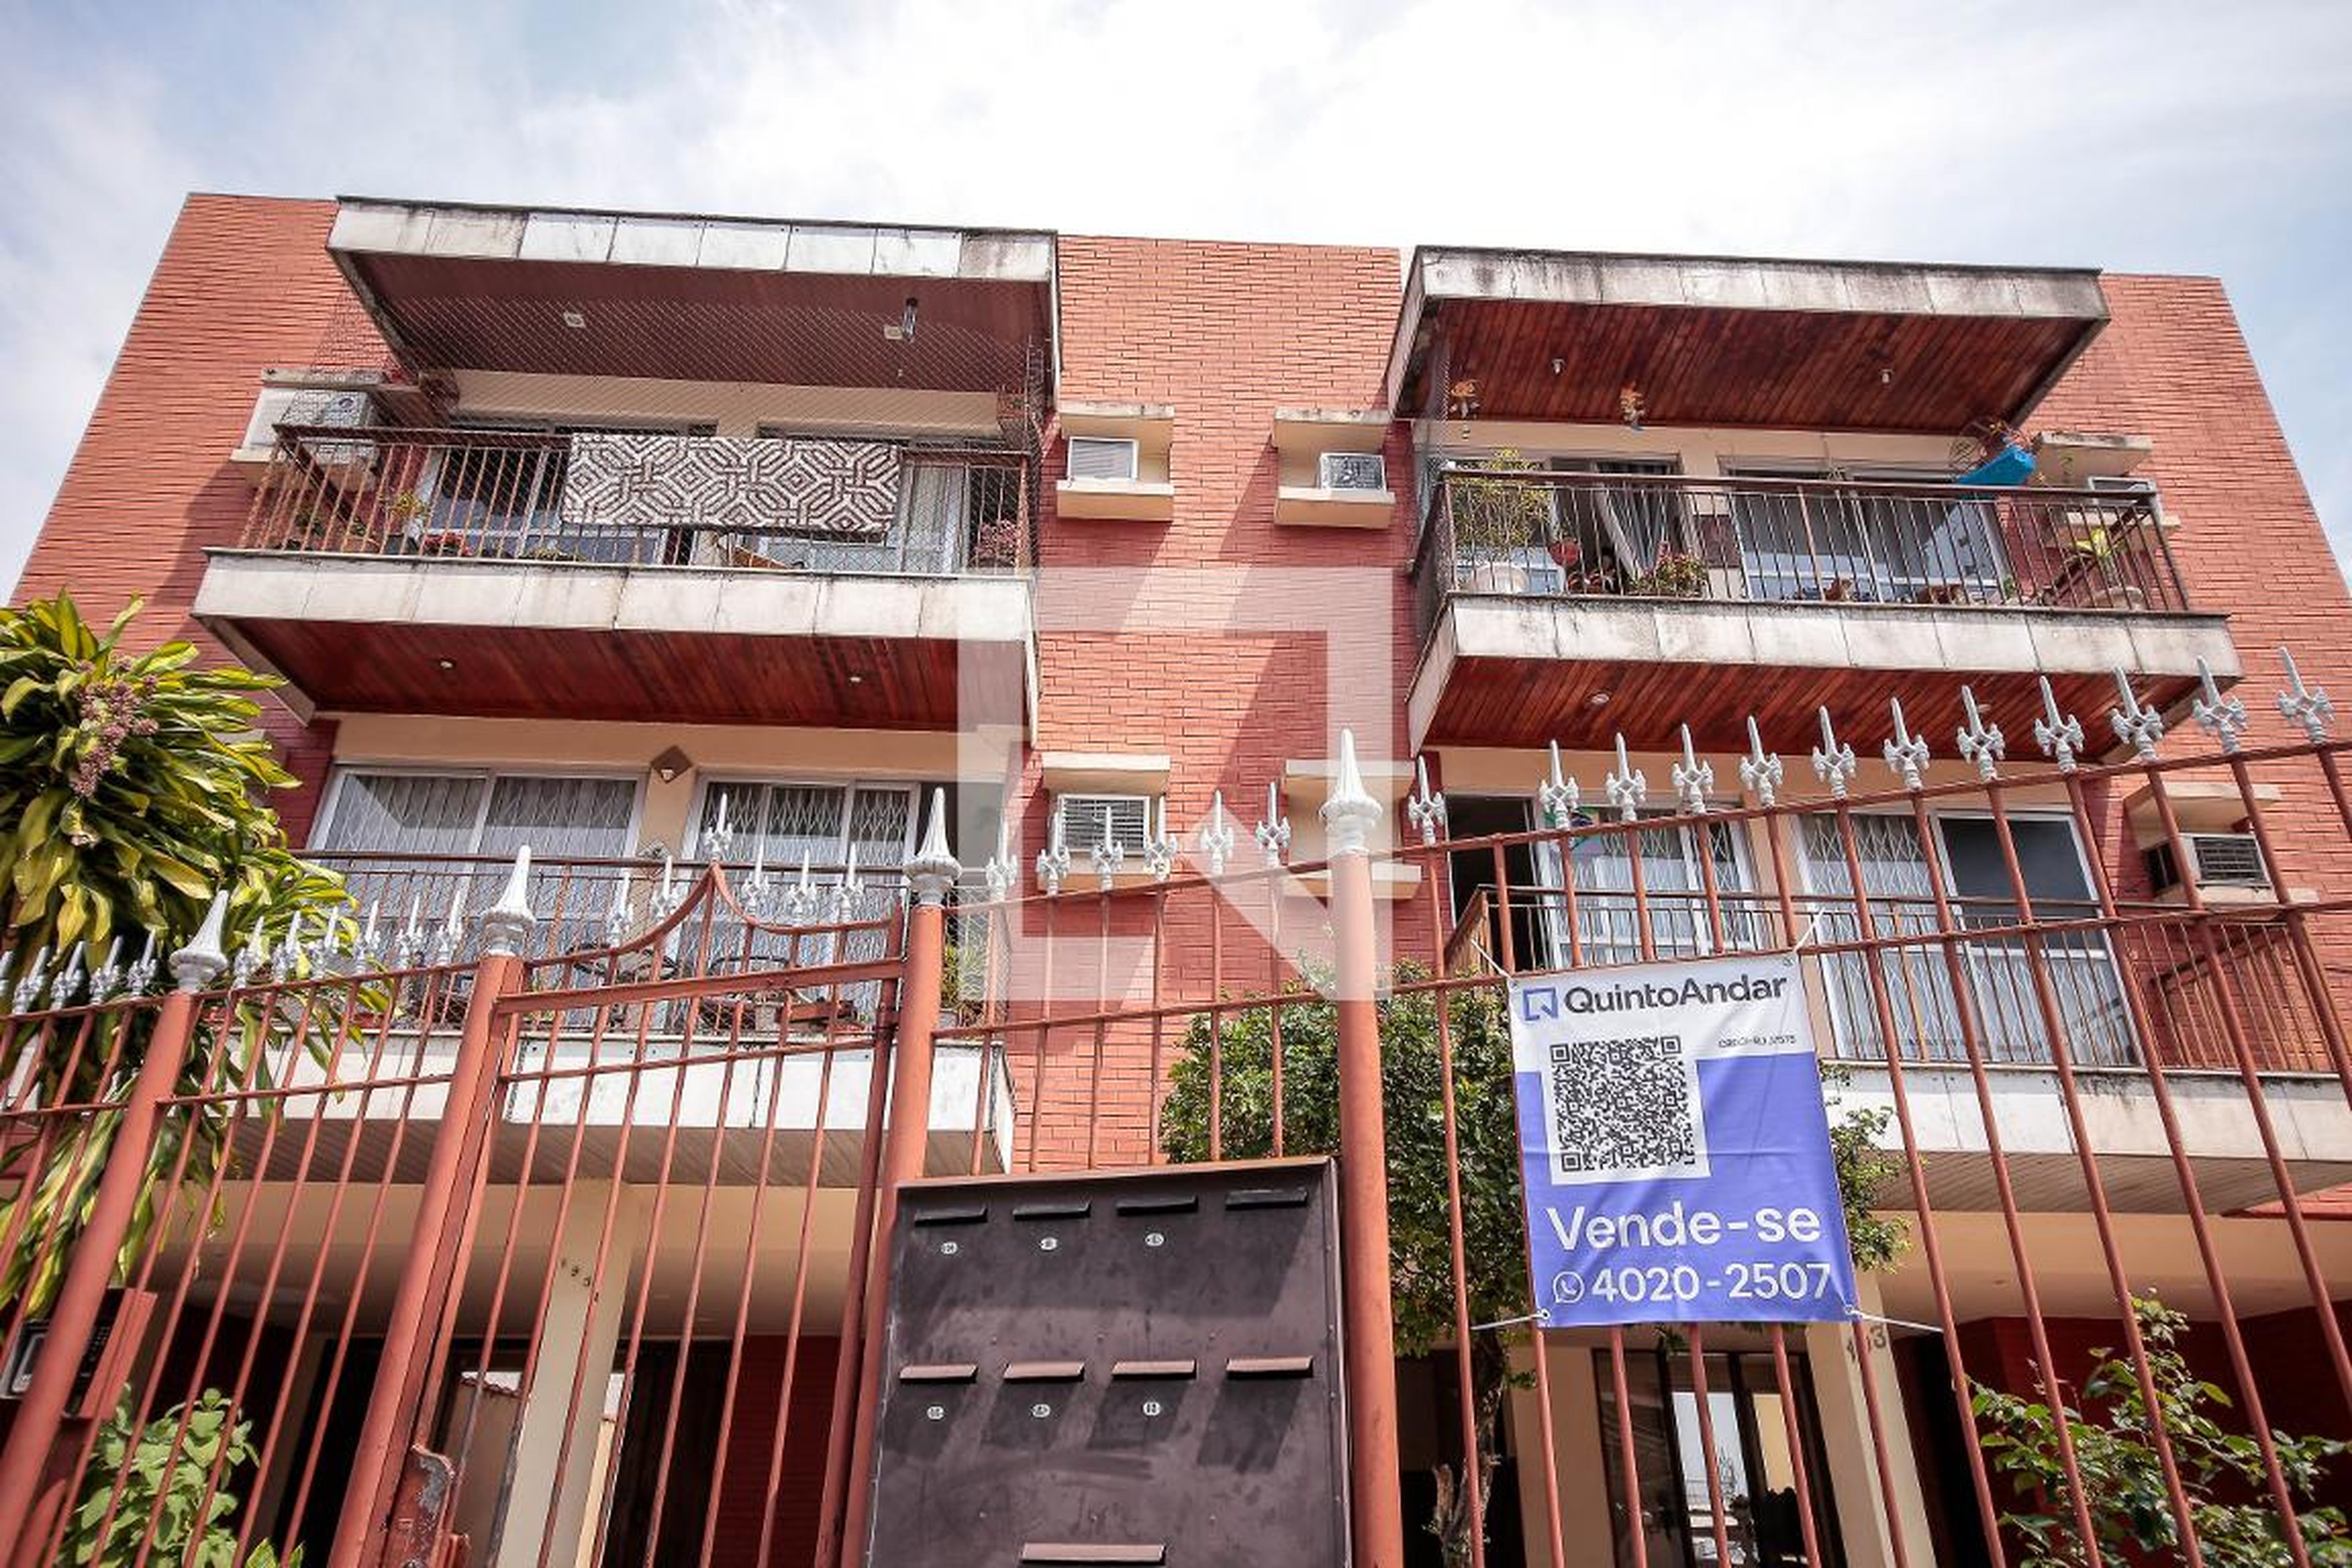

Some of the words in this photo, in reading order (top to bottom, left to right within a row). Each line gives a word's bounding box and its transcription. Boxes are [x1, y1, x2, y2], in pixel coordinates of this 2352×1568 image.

[1565, 974, 1787, 1014] QuintoAndar
[1547, 1201, 1820, 1250] Vende-se
[1593, 1262, 1831, 1302] 4020-2507
